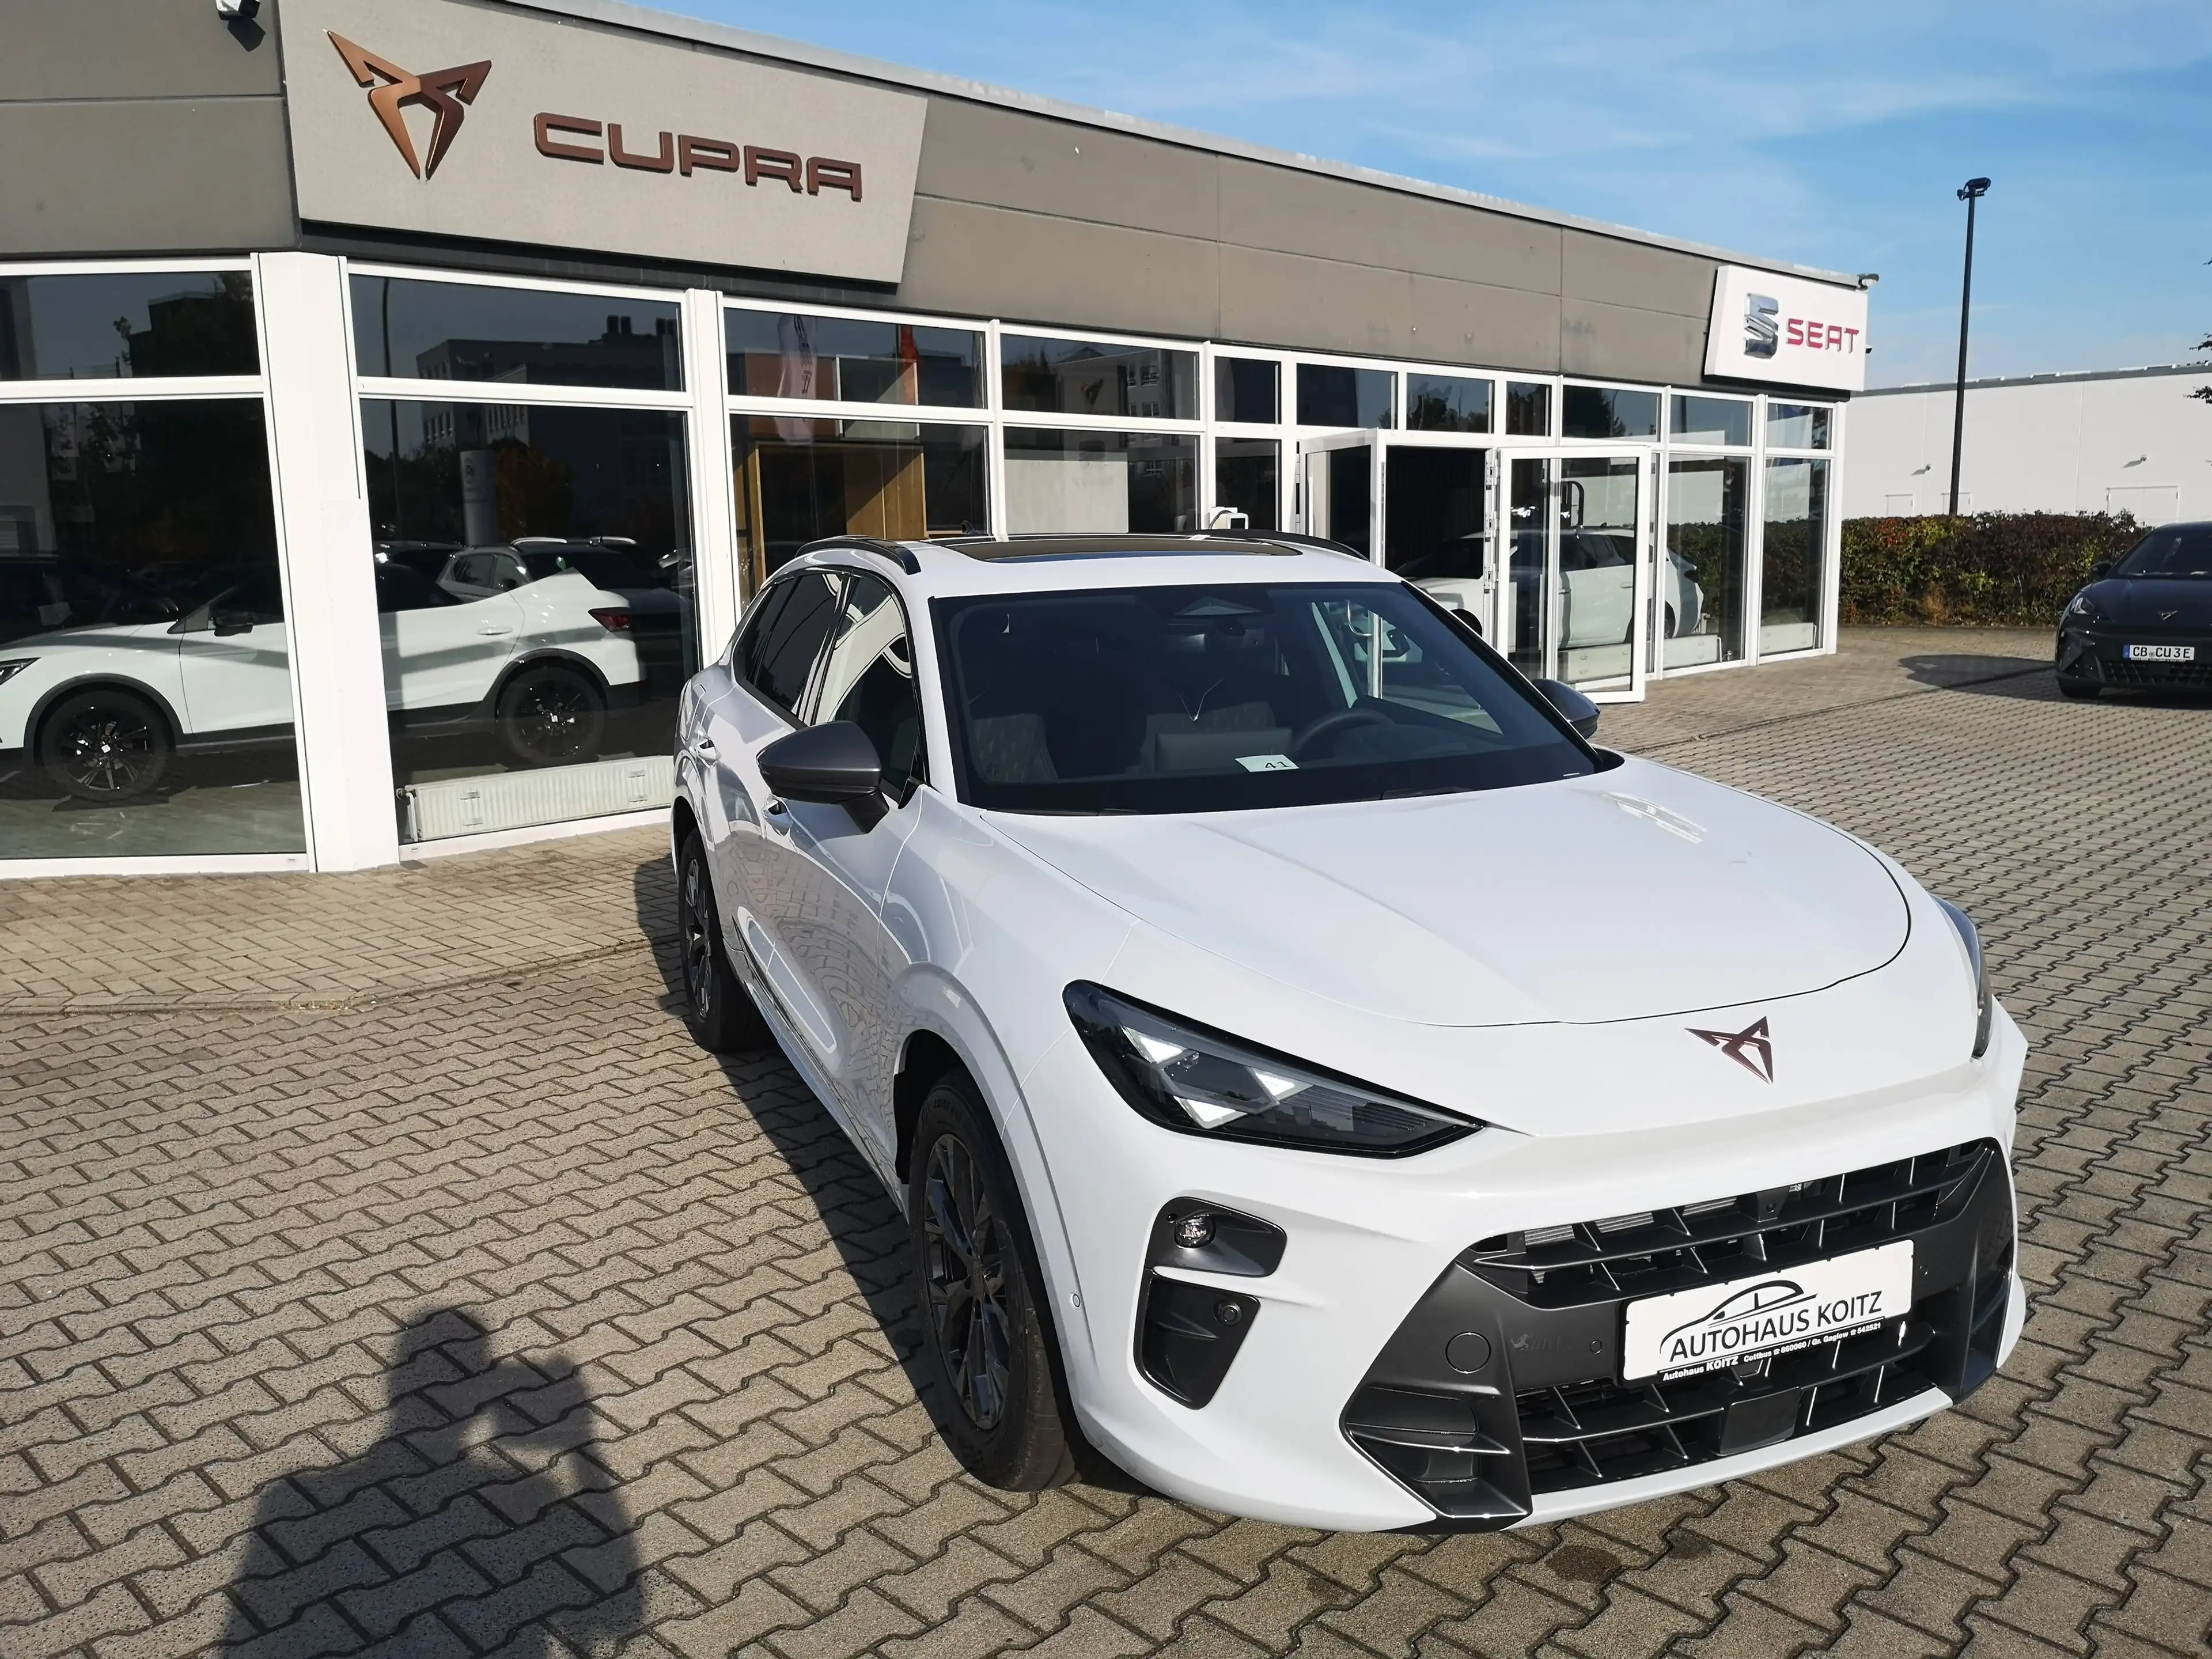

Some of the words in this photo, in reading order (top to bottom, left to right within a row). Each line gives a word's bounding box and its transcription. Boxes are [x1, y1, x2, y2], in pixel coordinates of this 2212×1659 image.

[534, 112, 862, 203] CUPRA
[1786, 318, 1859, 354] SEAT
[2133, 646, 2148, 657] CB
[1662, 1366, 1705, 1381] Autohaus
[1706, 1355, 1739, 1372] KOITZ
[1743, 1350, 1772, 1363] Cottbus
[1781, 1341, 1807, 1354] 860060
[1812, 1338, 1822, 1346] Gr.
[1823, 1331, 1849, 1343] Gaglow
[1857, 1321, 1881, 1334] 542521
[1669, 1309, 1810, 1363] AUTOHAUS
[1817, 1290, 1883, 1327] KOITZ
